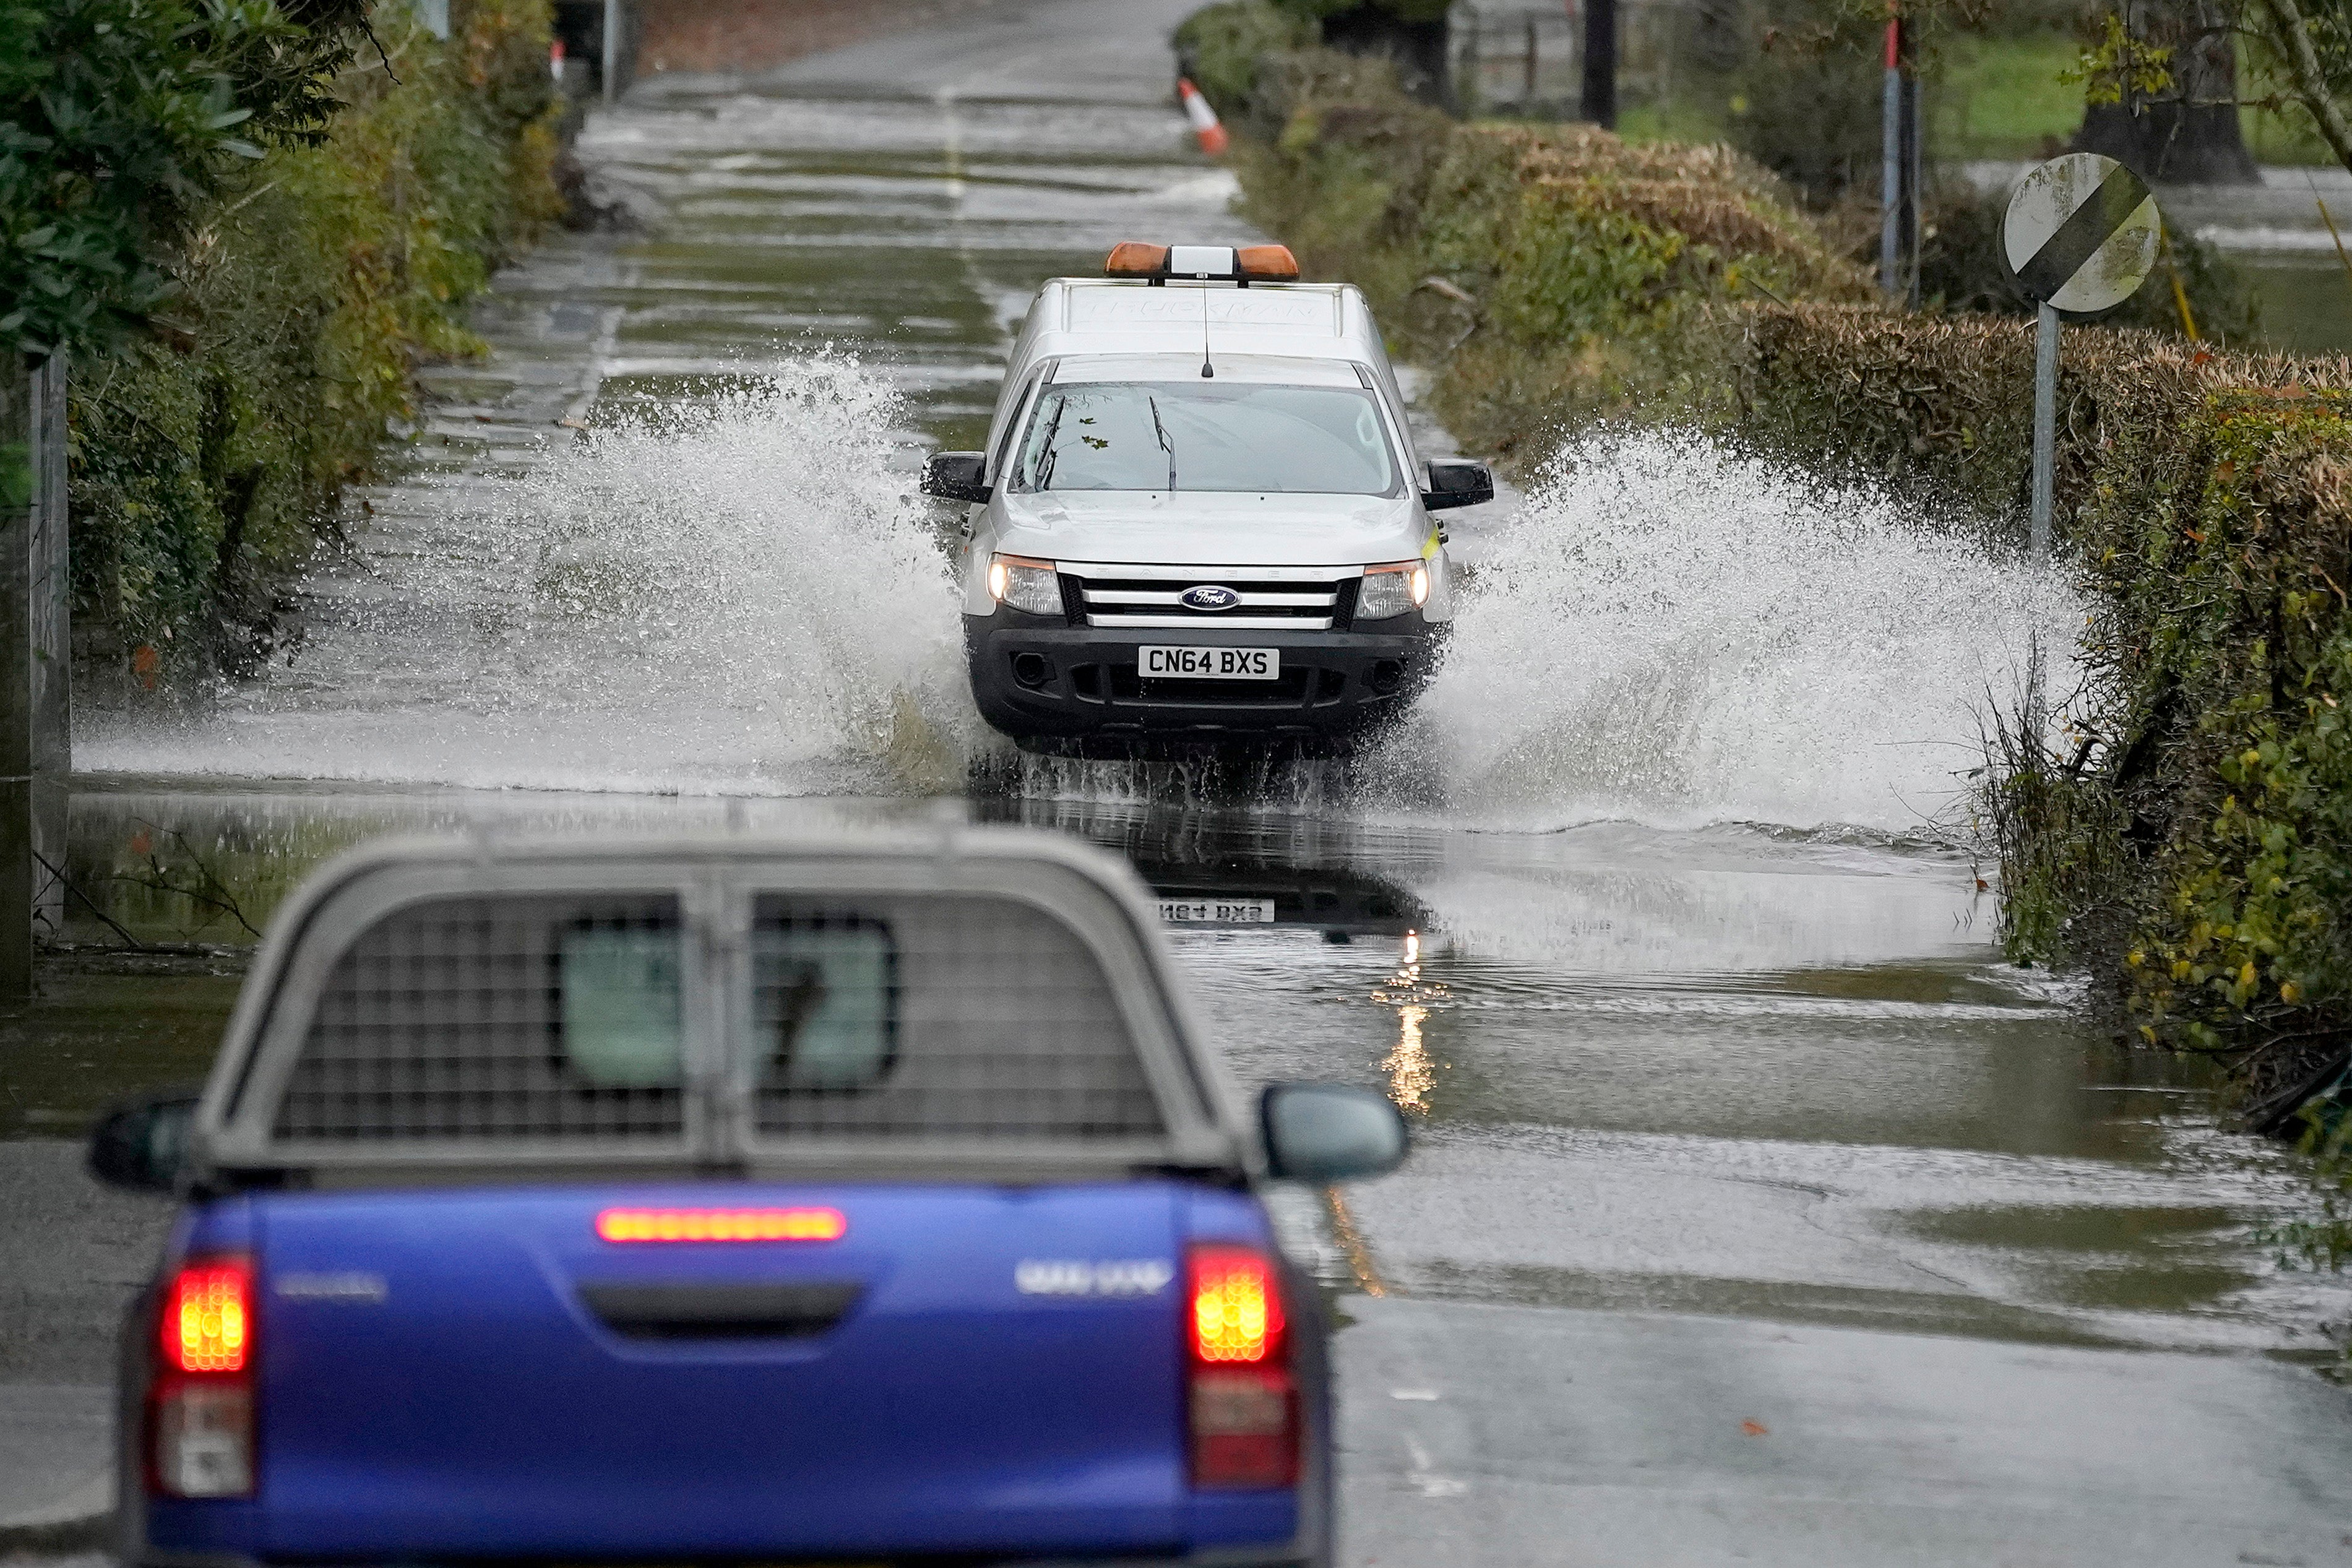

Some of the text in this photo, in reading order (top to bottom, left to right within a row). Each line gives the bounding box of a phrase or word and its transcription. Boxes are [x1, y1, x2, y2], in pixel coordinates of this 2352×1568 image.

[1096, 567, 1324, 579] RANGER
[1193, 589, 1226, 604] Ford
[1149, 649, 1267, 674] CN64 BXS
